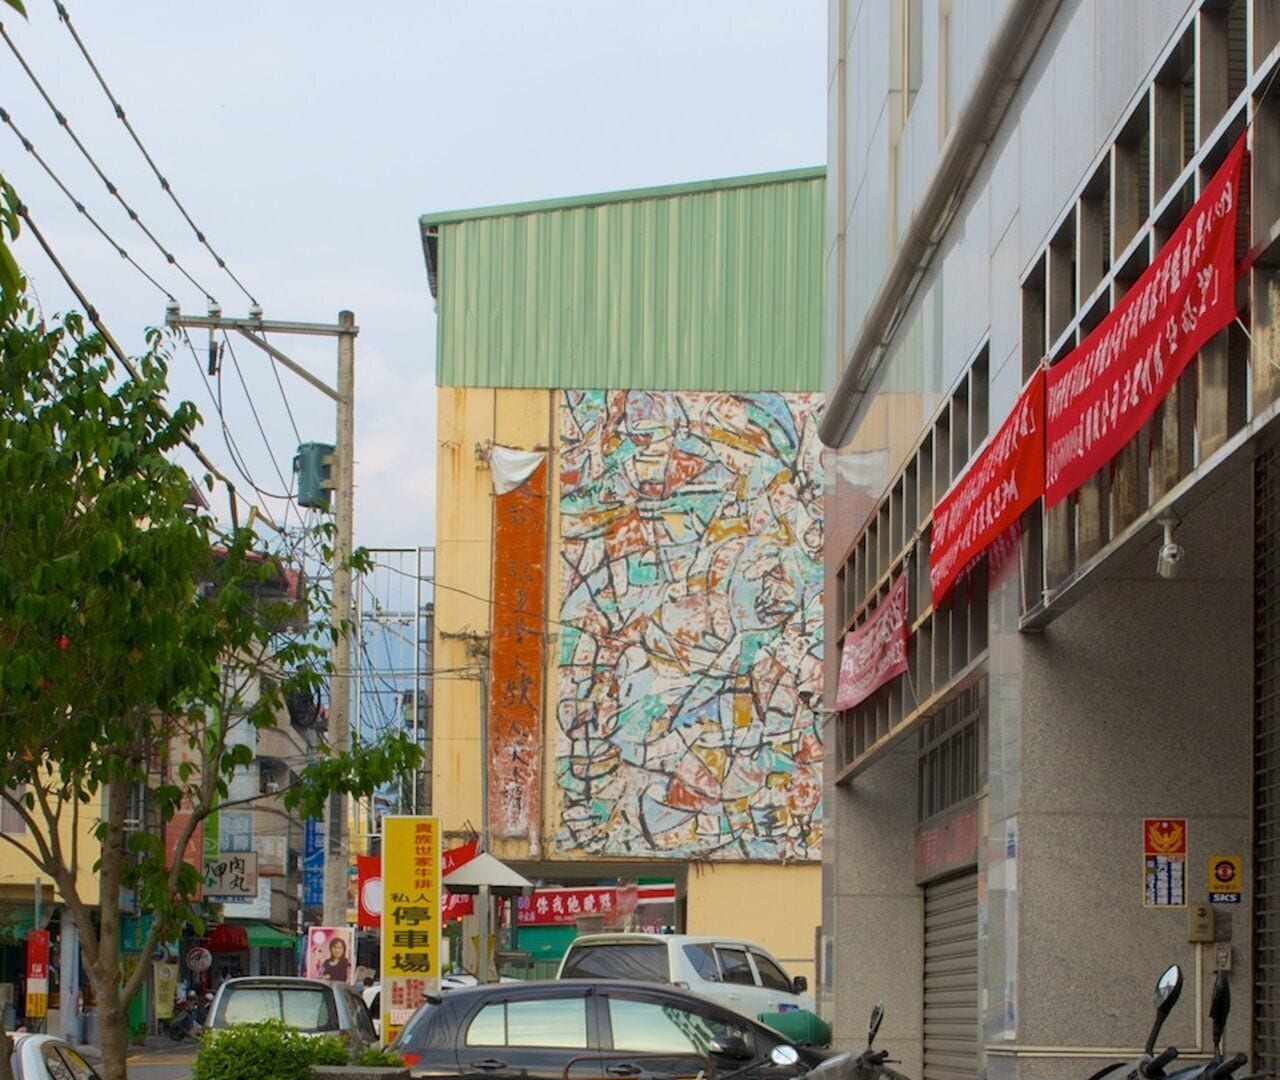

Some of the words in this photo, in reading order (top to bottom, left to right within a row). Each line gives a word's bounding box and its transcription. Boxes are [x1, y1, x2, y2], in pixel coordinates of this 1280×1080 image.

[229, 856, 250, 892] 肉丸
[415, 823, 433, 890] 貴族世家牛排
[390, 892, 432, 904] 私人
[1212, 893, 1237, 902] SKS
[391, 906, 432, 972] 停車場
